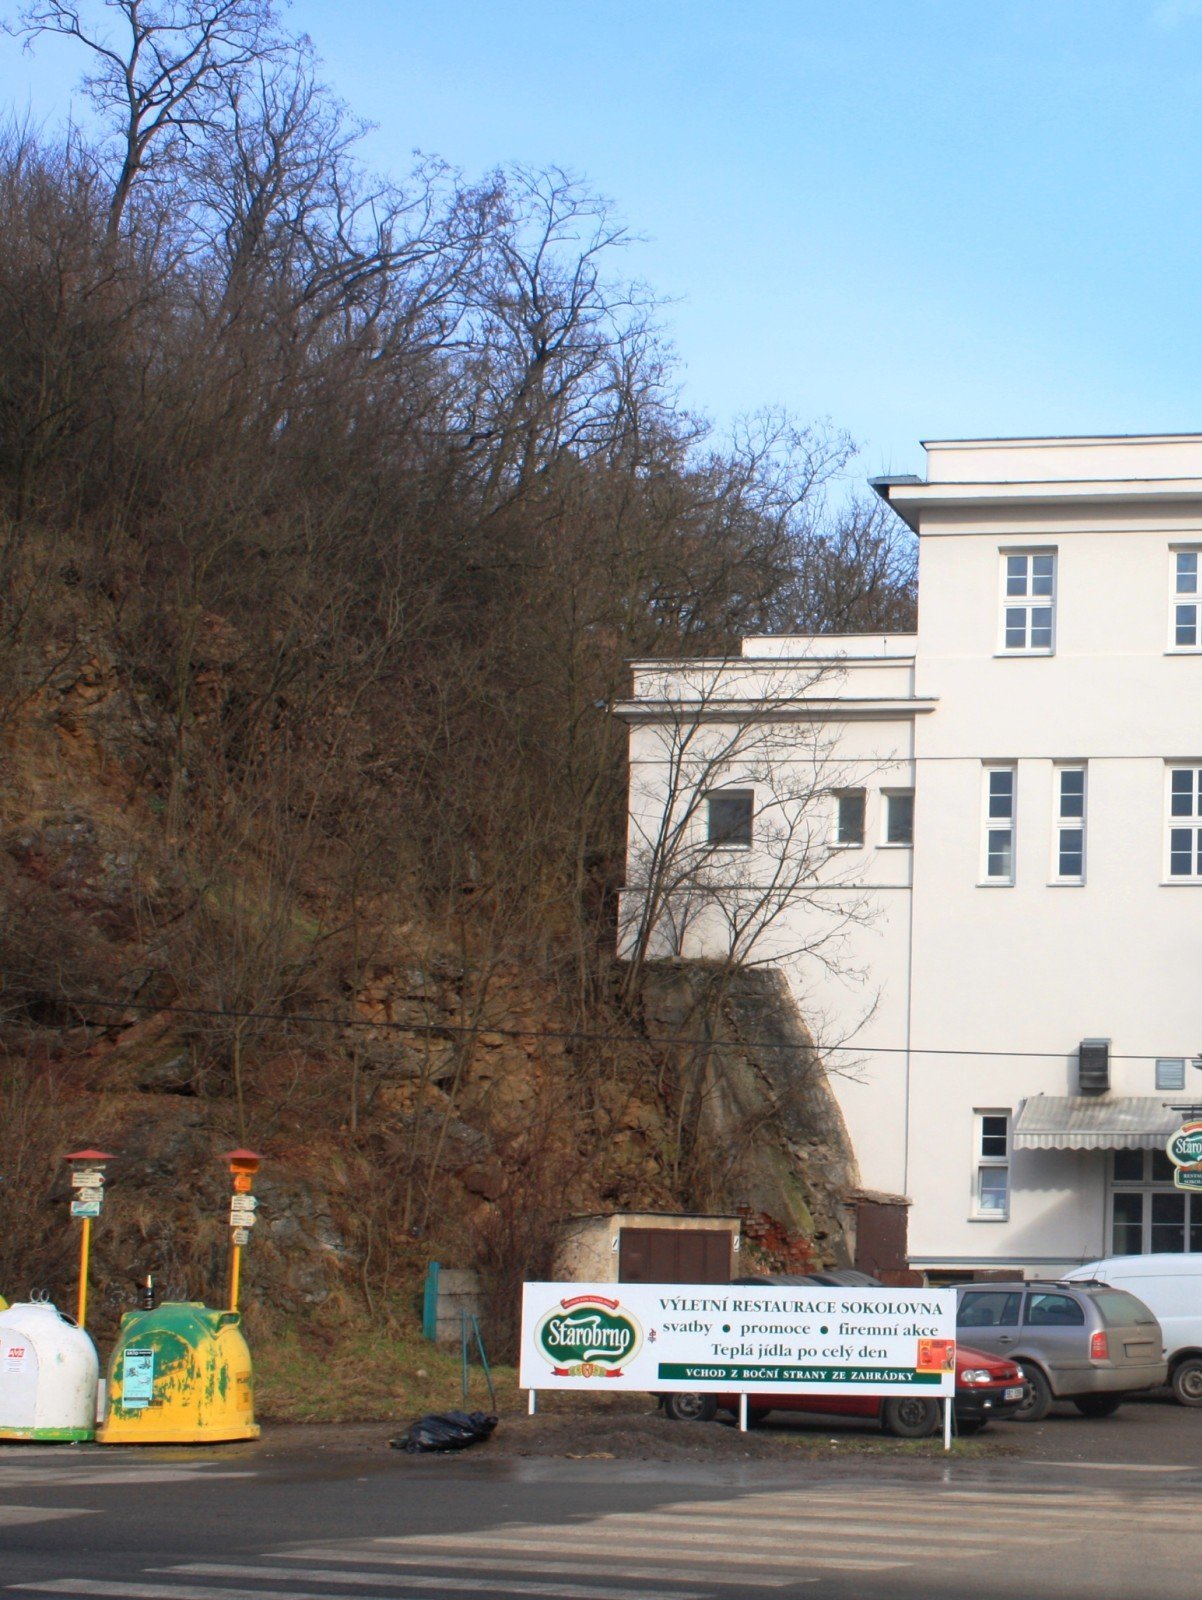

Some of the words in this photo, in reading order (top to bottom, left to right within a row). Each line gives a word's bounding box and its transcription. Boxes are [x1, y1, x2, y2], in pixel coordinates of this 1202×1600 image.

[659, 1296, 728, 1312] VÝLETNÍ
[733, 1300, 836, 1314] RESTAURACE
[841, 1301, 943, 1315] SOKOLOVNA
[548, 1315, 631, 1360] Starobrno
[662, 1320, 713, 1336] svatby
[741, 1323, 811, 1337] promoce
[838, 1322, 899, 1336] firemní
[903, 1323, 939, 1336] akce
[711, 1343, 754, 1359] Teplá
[757, 1343, 792, 1359] jídla
[797, 1347, 817, 1361] po
[822, 1345, 854, 1361] celý
[858, 1345, 888, 1358] den
[685, 1368, 726, 1378] VCHOD
[731, 1369, 738, 1377] Z
[743, 1368, 779, 1378] BOČNÍ
[783, 1370, 827, 1379] STRANY
[832, 1371, 846, 1379] ZE
[851, 1369, 914, 1381] ZAHRÁDKY
